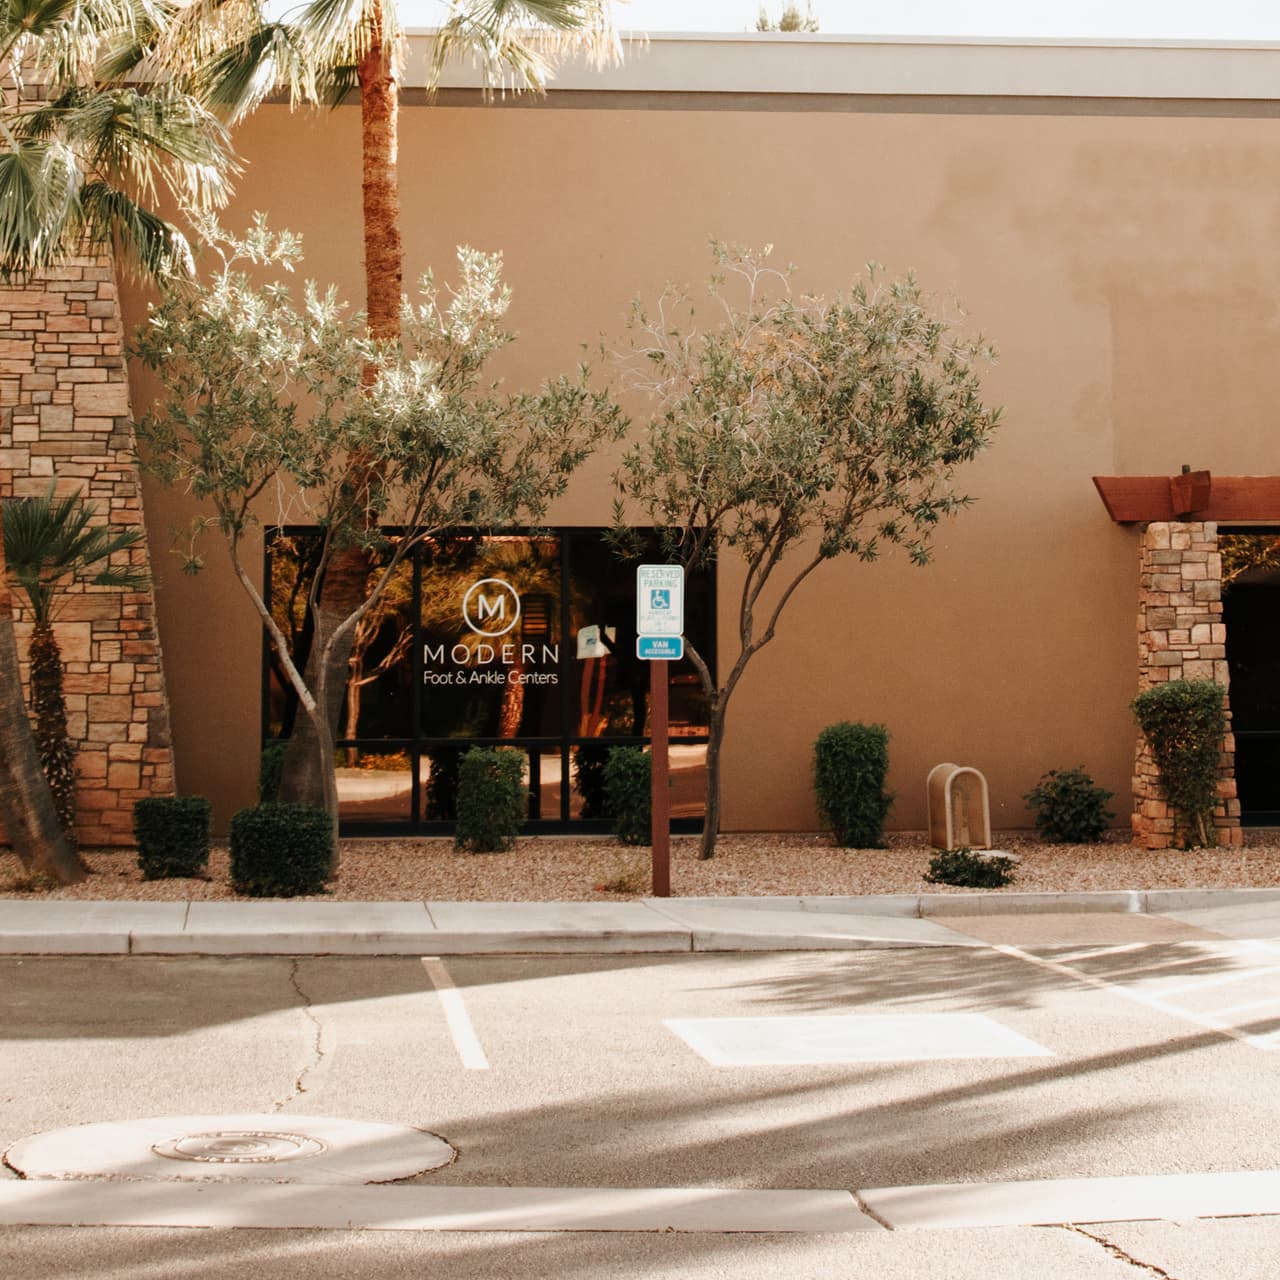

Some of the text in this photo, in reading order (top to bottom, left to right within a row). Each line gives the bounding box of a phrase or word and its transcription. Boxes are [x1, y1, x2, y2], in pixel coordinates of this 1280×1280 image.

[640, 569, 680, 578] RESERVED
[644, 579, 678, 588] PARKING
[478, 594, 504, 619] M
[652, 640, 669, 648] VAN
[423, 644, 559, 664] MODERN
[423, 670, 559, 685] Foot & Ankle Centers
